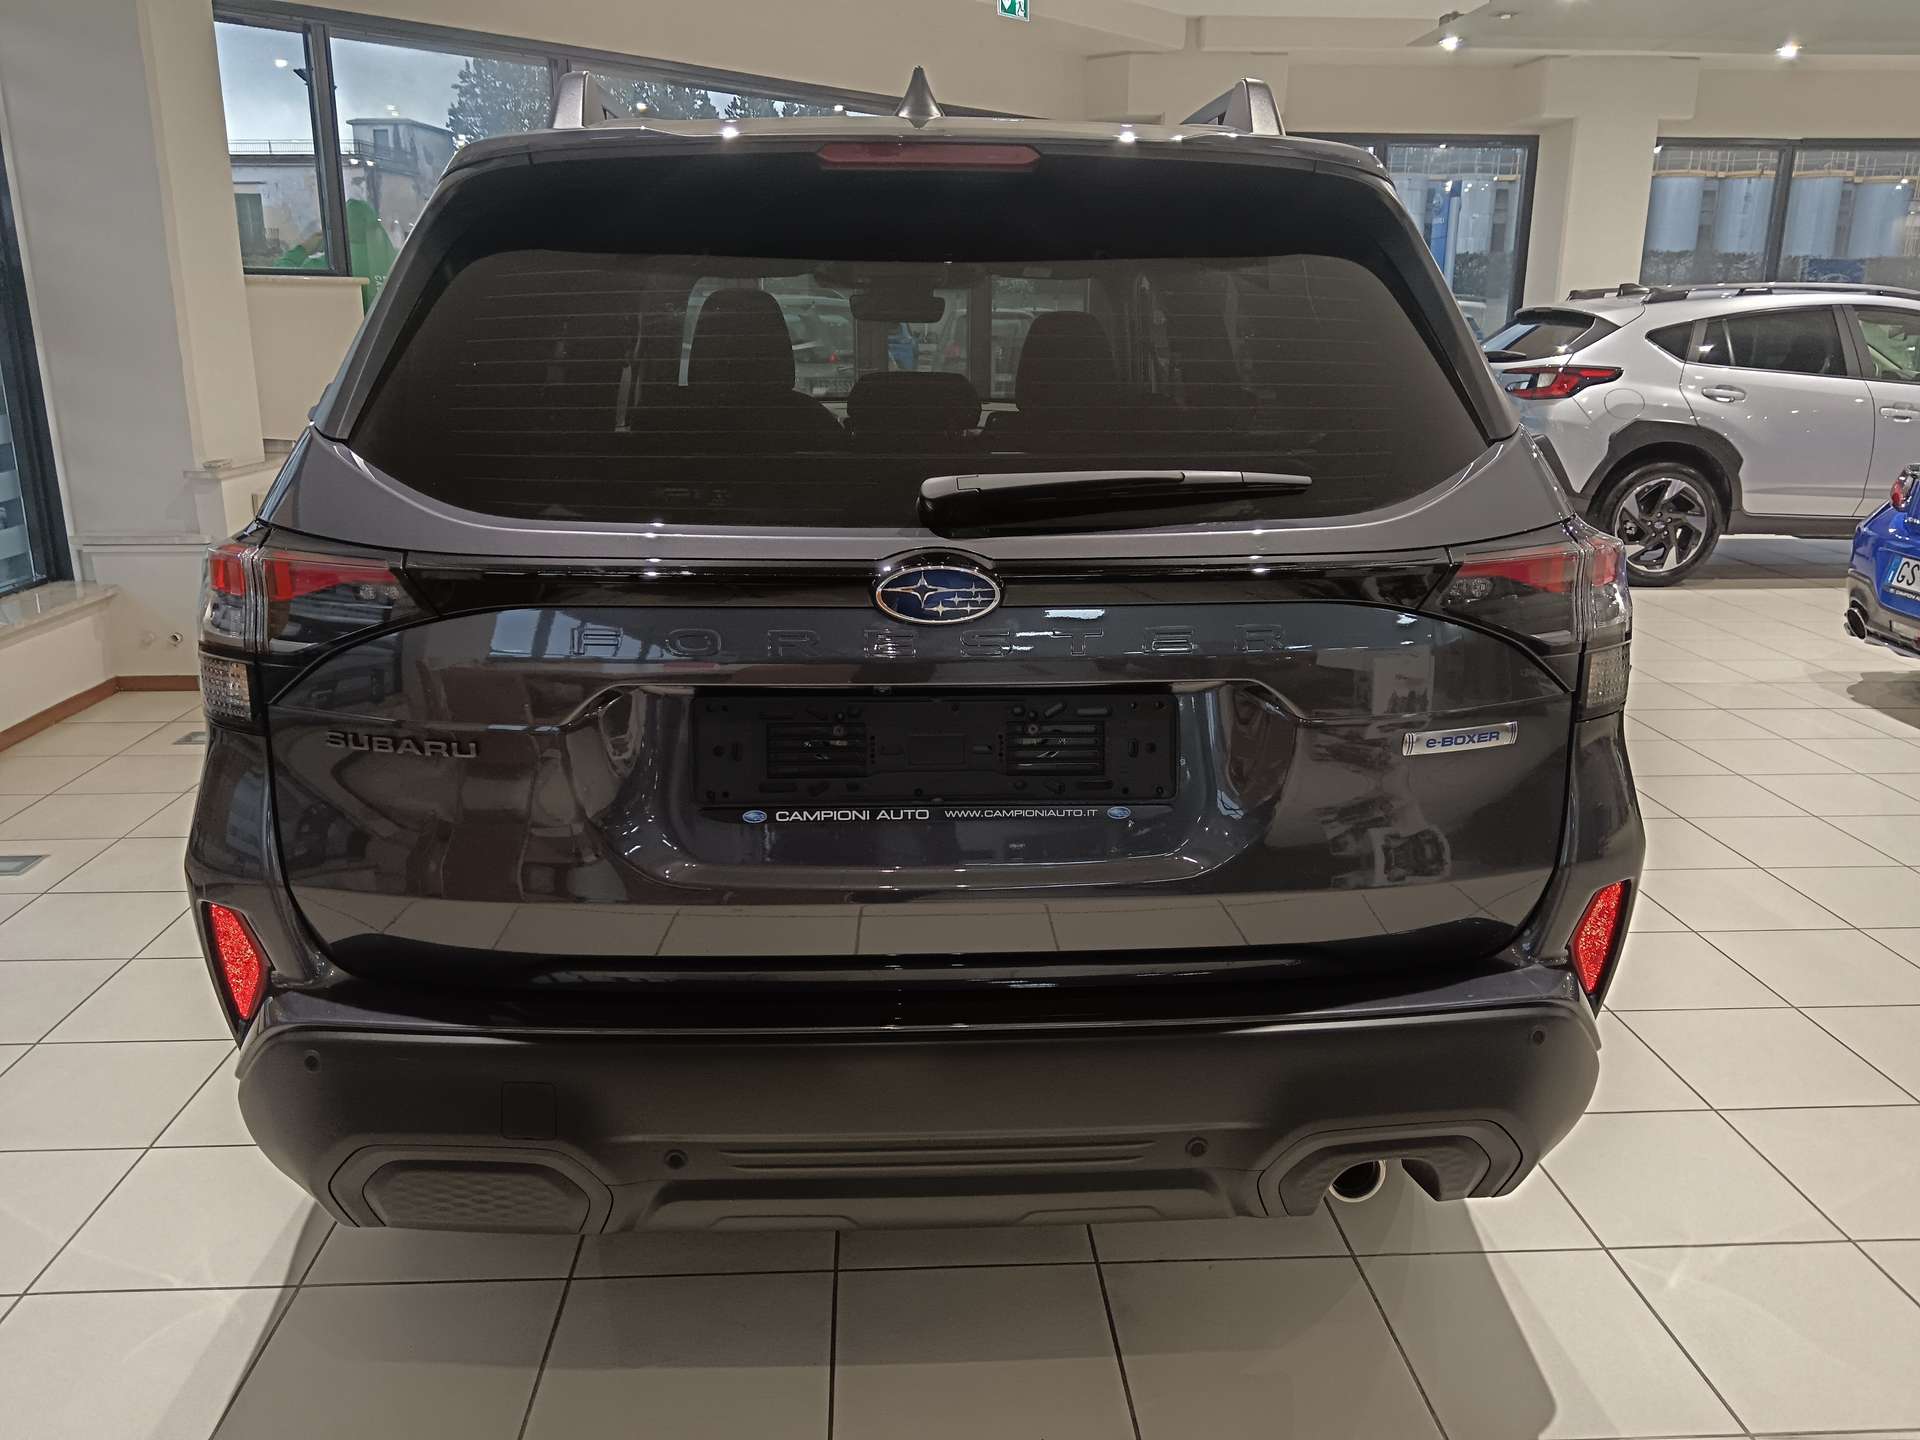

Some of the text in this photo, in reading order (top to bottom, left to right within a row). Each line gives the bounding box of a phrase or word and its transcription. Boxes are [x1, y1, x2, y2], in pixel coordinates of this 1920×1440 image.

[569, 622, 1286, 658] FORESTER
[326, 729, 477, 758] SUBARU
[1426, 731, 1500, 748] e-BOXER
[775, 809, 1098, 822] CAMPIONI AUTO WWW.CAMPIONIAUTO.IT
